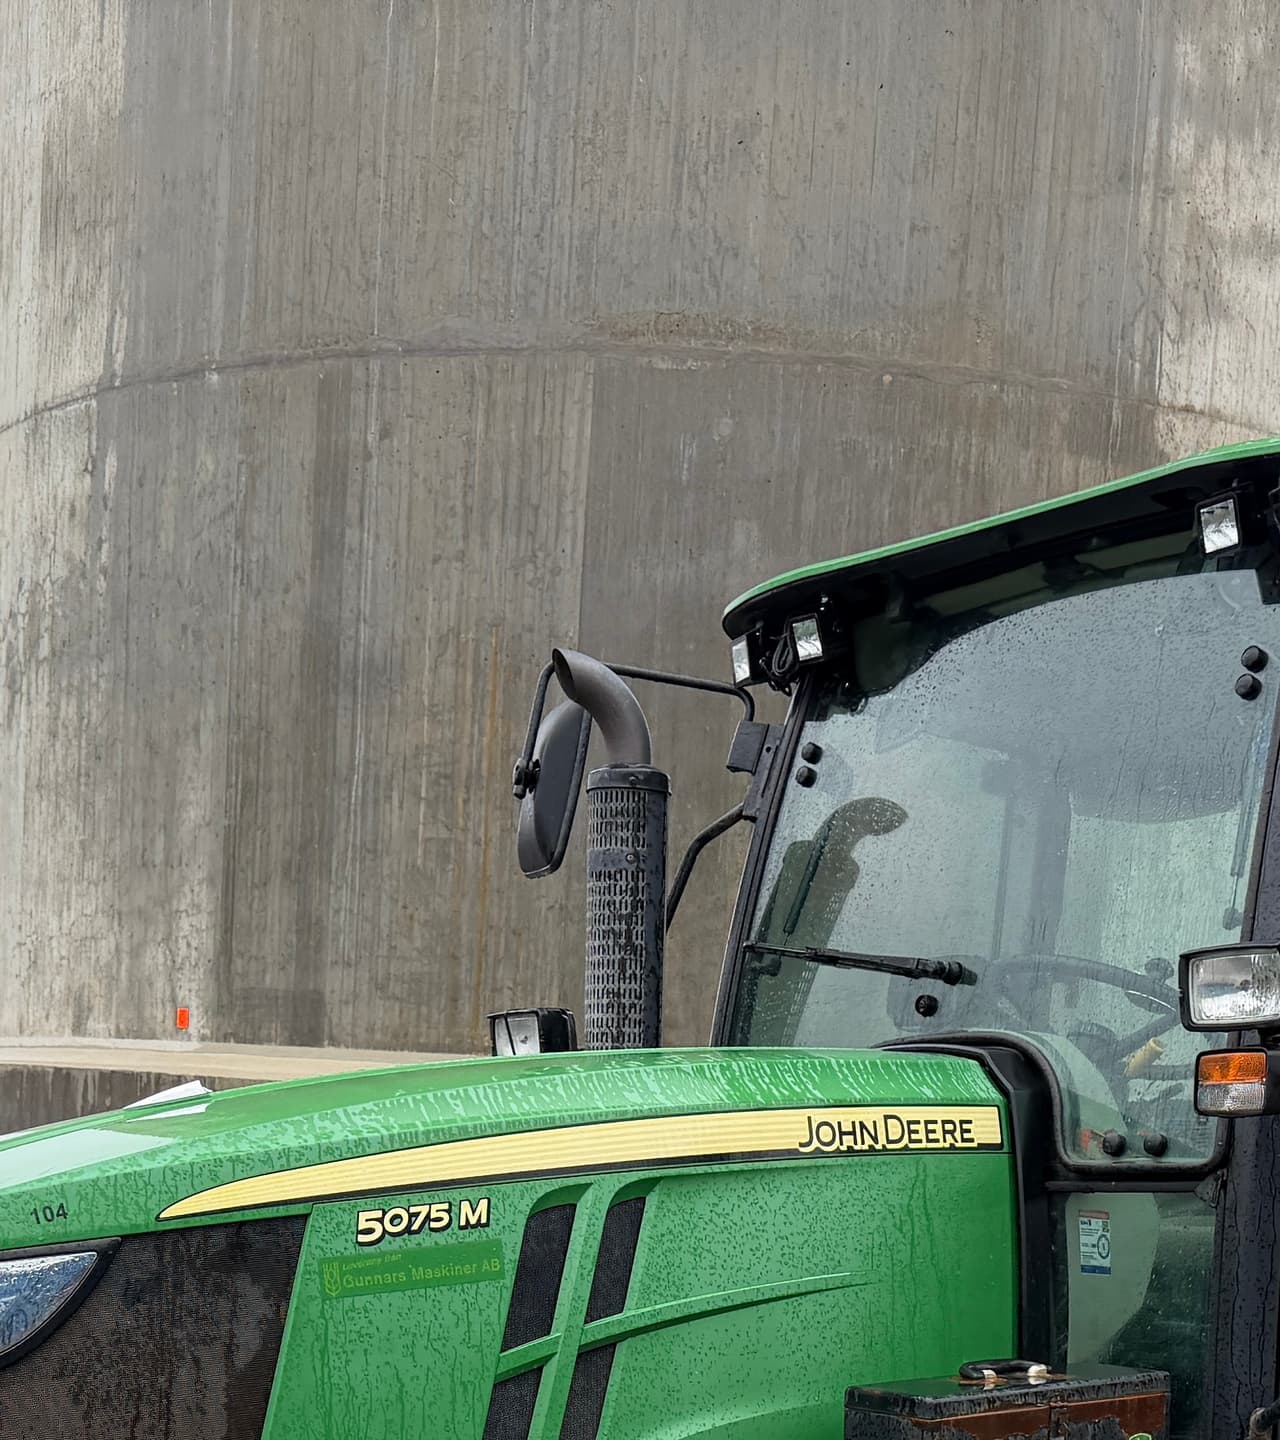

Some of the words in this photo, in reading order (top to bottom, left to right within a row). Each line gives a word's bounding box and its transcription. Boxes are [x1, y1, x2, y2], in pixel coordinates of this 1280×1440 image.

[798, 1116, 879, 1149] JOHN
[883, 1114, 976, 1145] DEERE
[30, 1203, 68, 1224] 104
[356, 1202, 452, 1247] 5075
[459, 1197, 491, 1230] M
[343, 1270, 407, 1289] Gunnars
[411, 1262, 477, 1282] Maskiner
[481, 1258, 501, 1273] AB
